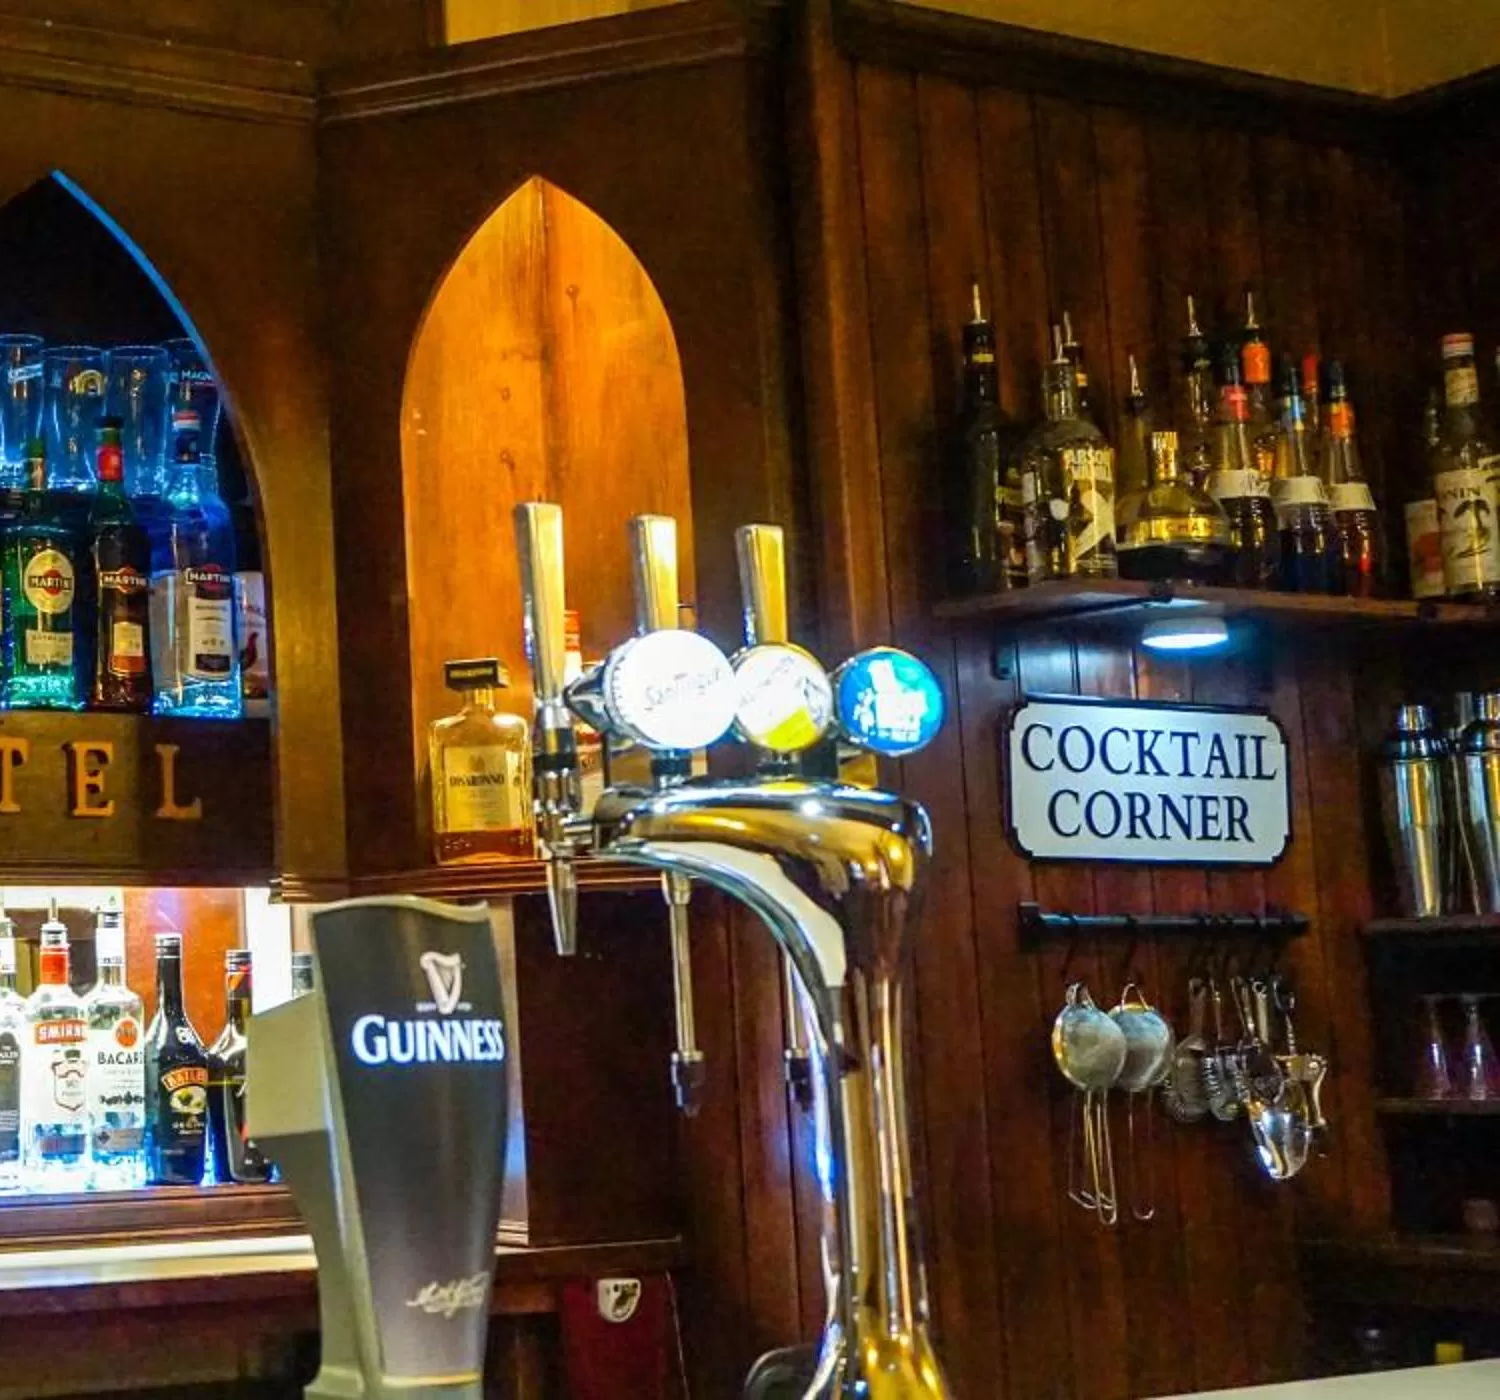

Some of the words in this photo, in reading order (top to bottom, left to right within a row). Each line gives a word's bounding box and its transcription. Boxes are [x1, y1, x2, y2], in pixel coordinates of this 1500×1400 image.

[1021, 723, 1277, 780] COCKTAIL
[1048, 789, 1254, 843] CORNER
[352, 1014, 504, 1065] GUINNESS
